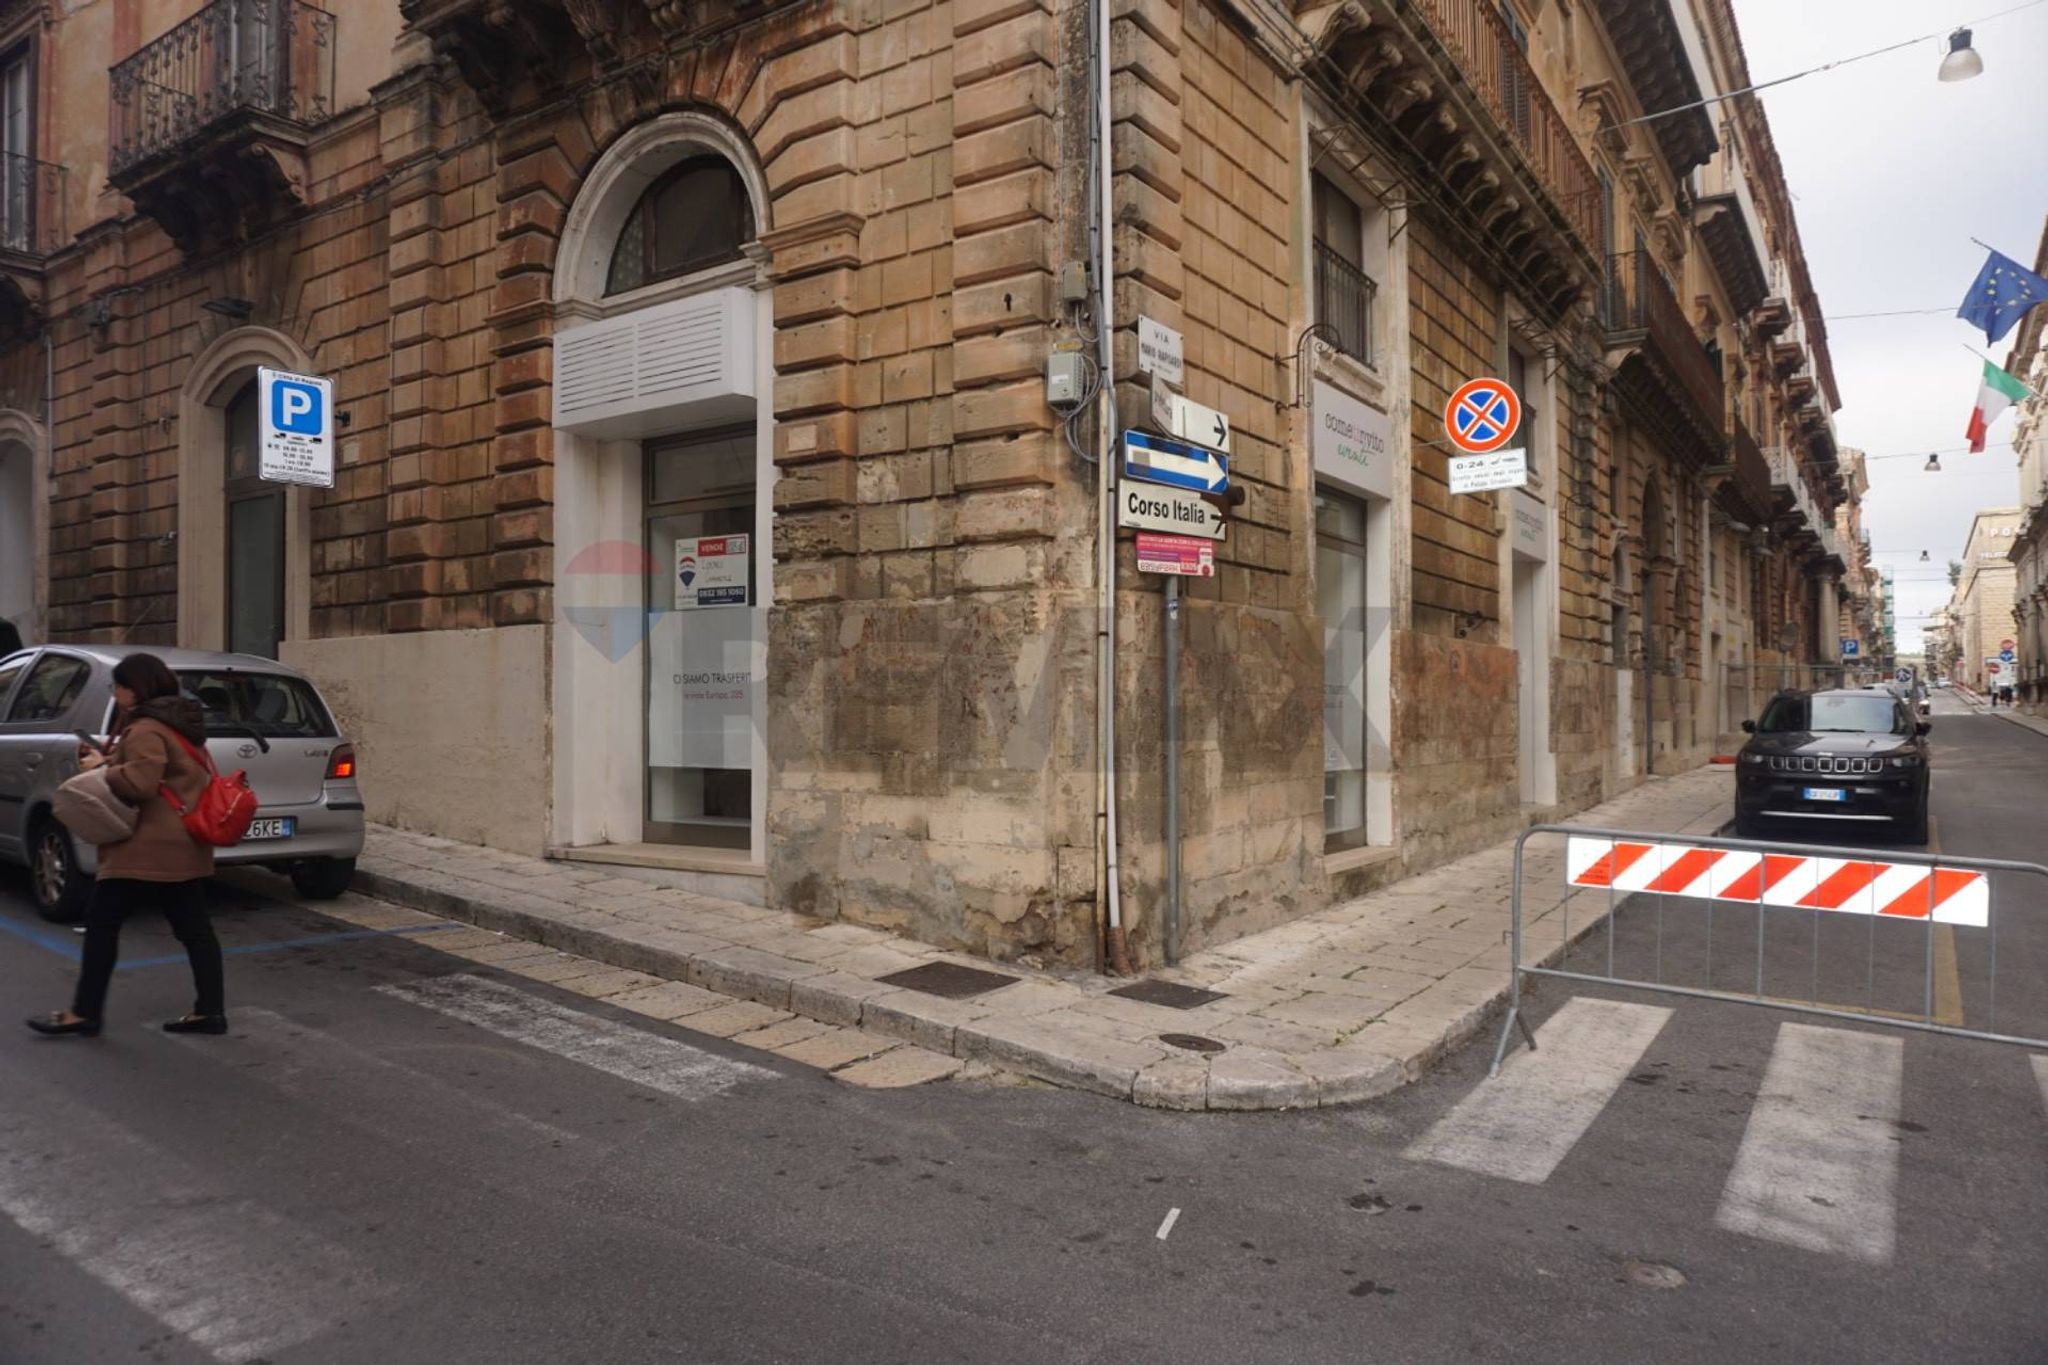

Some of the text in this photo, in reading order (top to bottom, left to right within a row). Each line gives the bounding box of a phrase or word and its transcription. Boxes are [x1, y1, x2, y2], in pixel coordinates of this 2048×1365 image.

[1153, 329, 1170, 343] VIA
[282, 387, 312, 426] P
[1128, 492, 1205, 524] Corso Italia
[701, 543, 724, 552] VENDE
[1845, 641, 1856, 653] P
[673, 674, 681, 684] CI
[682, 673, 710, 684] SIAMO
